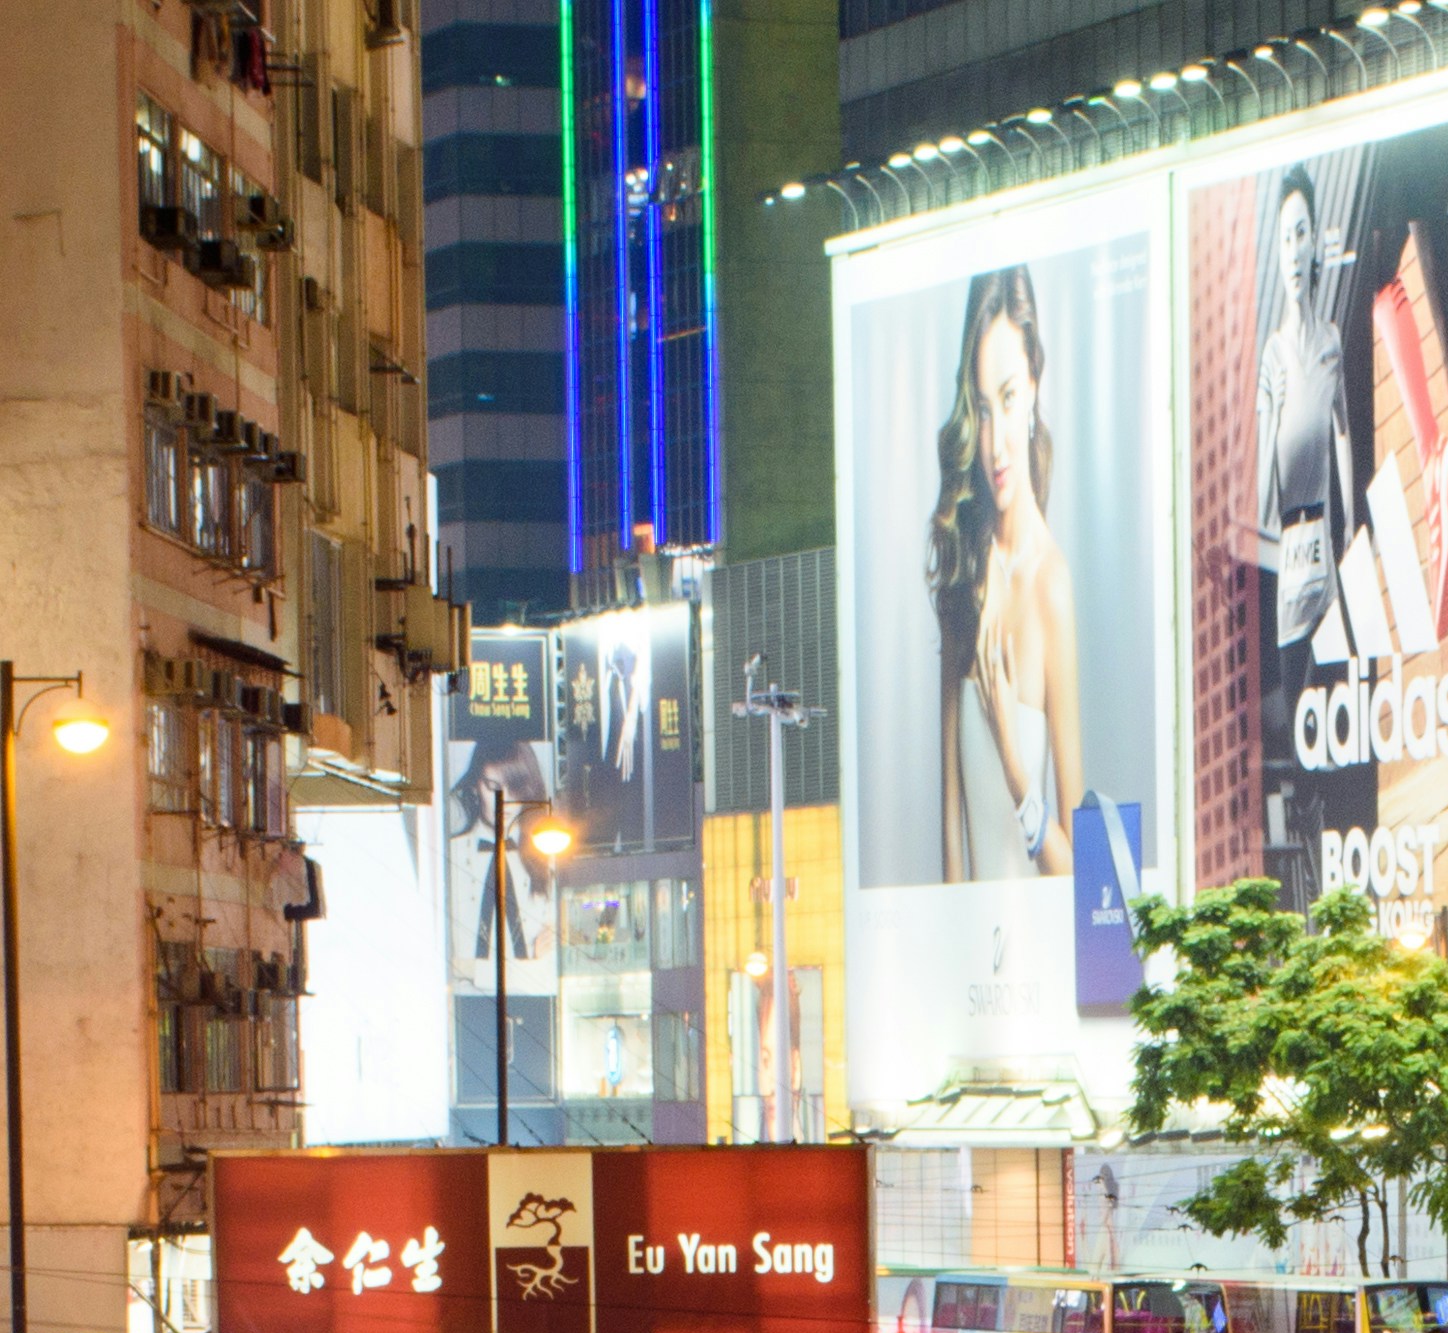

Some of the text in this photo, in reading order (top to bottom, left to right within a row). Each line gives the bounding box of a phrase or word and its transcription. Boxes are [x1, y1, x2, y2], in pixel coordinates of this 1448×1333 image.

[470, 662, 529, 702] 周生生
[1320, 825, 1440, 896] BOOST
[276, 1225, 446, 1296] 余仁生
[627, 1232, 835, 1283] Eu Yan Sang
